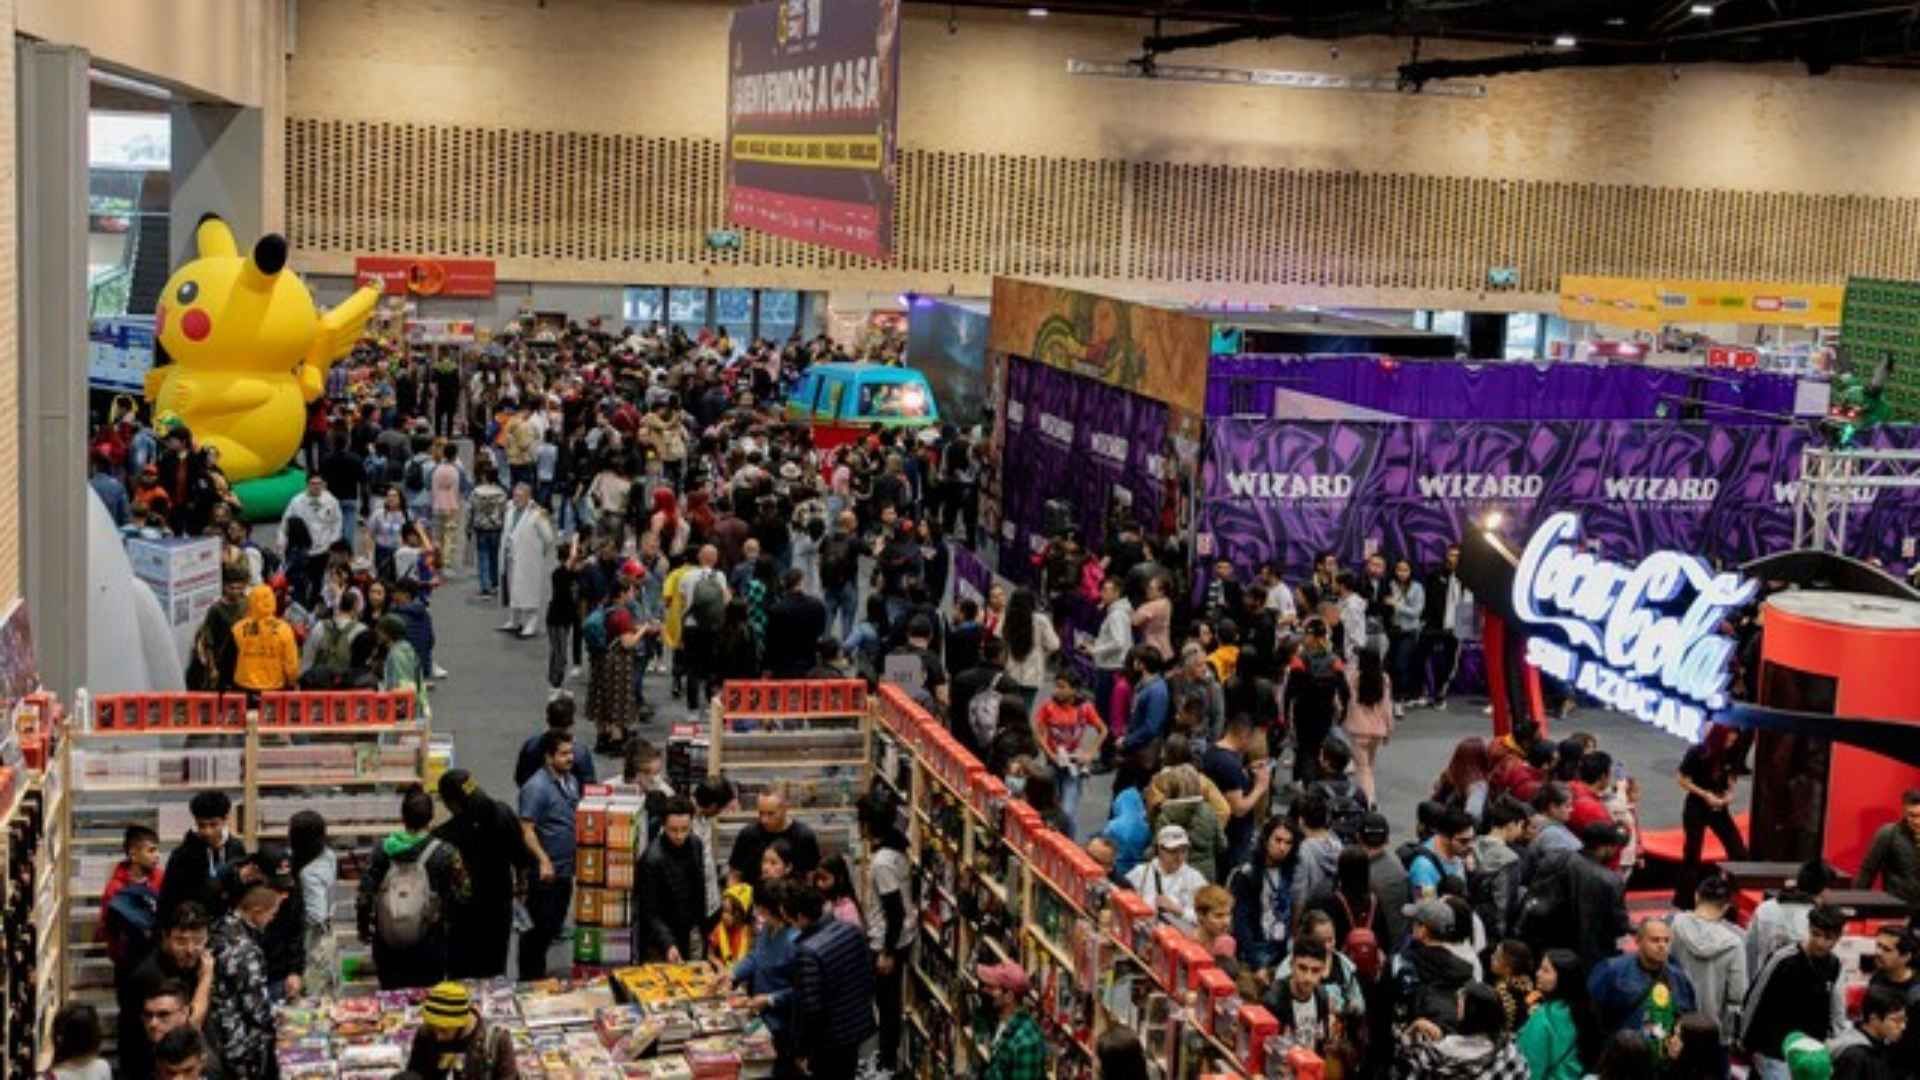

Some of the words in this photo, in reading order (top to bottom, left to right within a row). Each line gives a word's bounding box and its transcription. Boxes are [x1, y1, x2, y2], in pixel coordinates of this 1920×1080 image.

[735, 66, 815, 115] BIENVENIDOS
[816, 64, 829, 112] A
[831, 56, 880, 111] CASA
[1226, 471, 1351, 498] WIZARD
[1418, 474, 1543, 498] WIZARD
[1604, 477, 1720, 501] WIZARD
